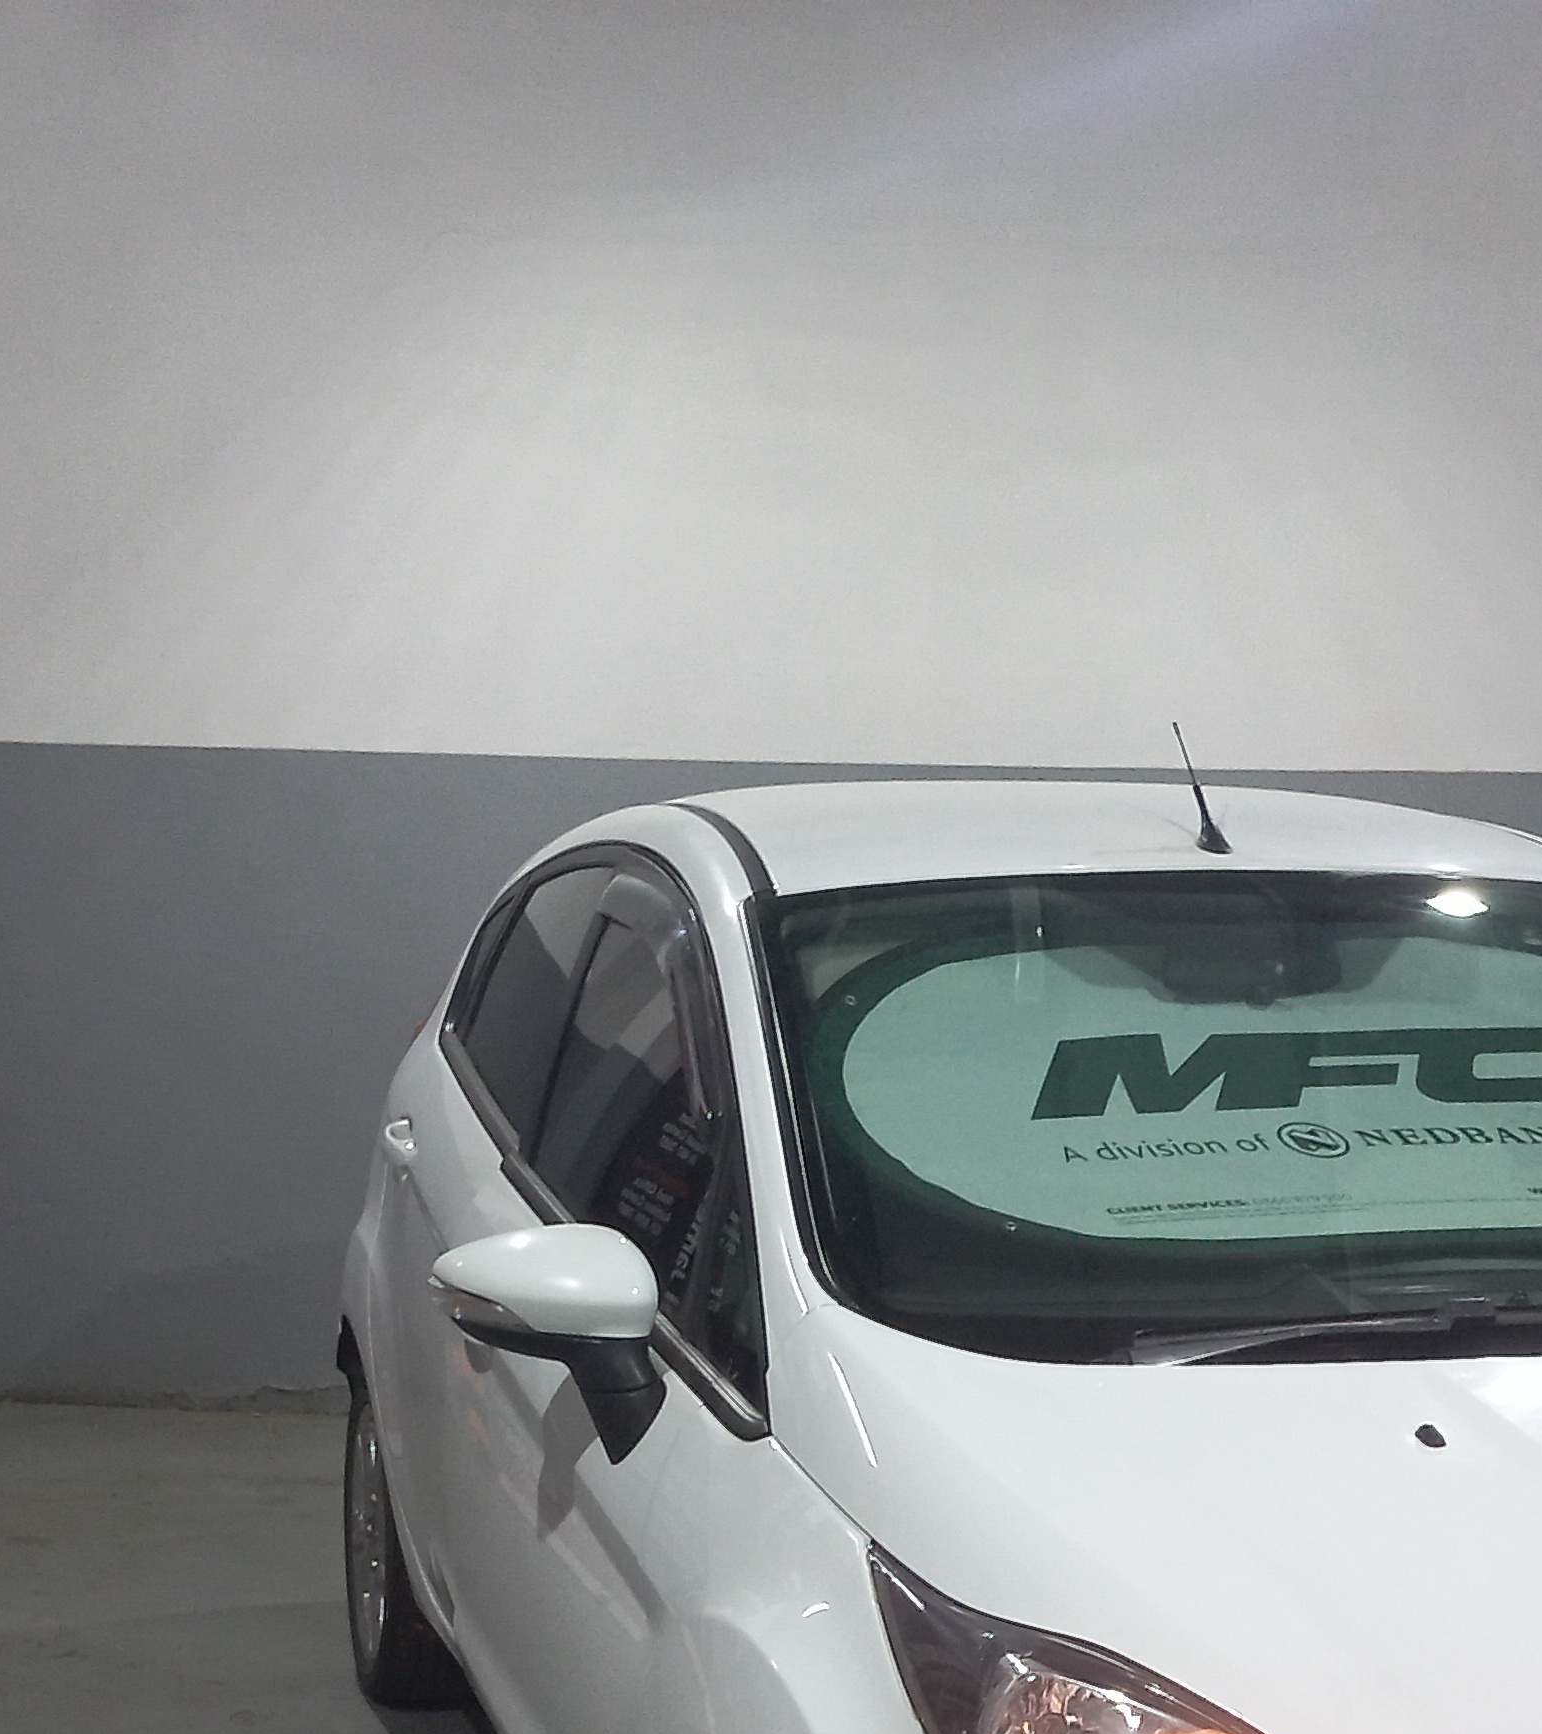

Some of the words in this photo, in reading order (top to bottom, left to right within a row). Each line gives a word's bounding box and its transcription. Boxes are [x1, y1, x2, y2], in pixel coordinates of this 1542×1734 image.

[1063, 1146, 1088, 1163] A
[1096, 1138, 1227, 1160] division
[1236, 1133, 1270, 1152] of
